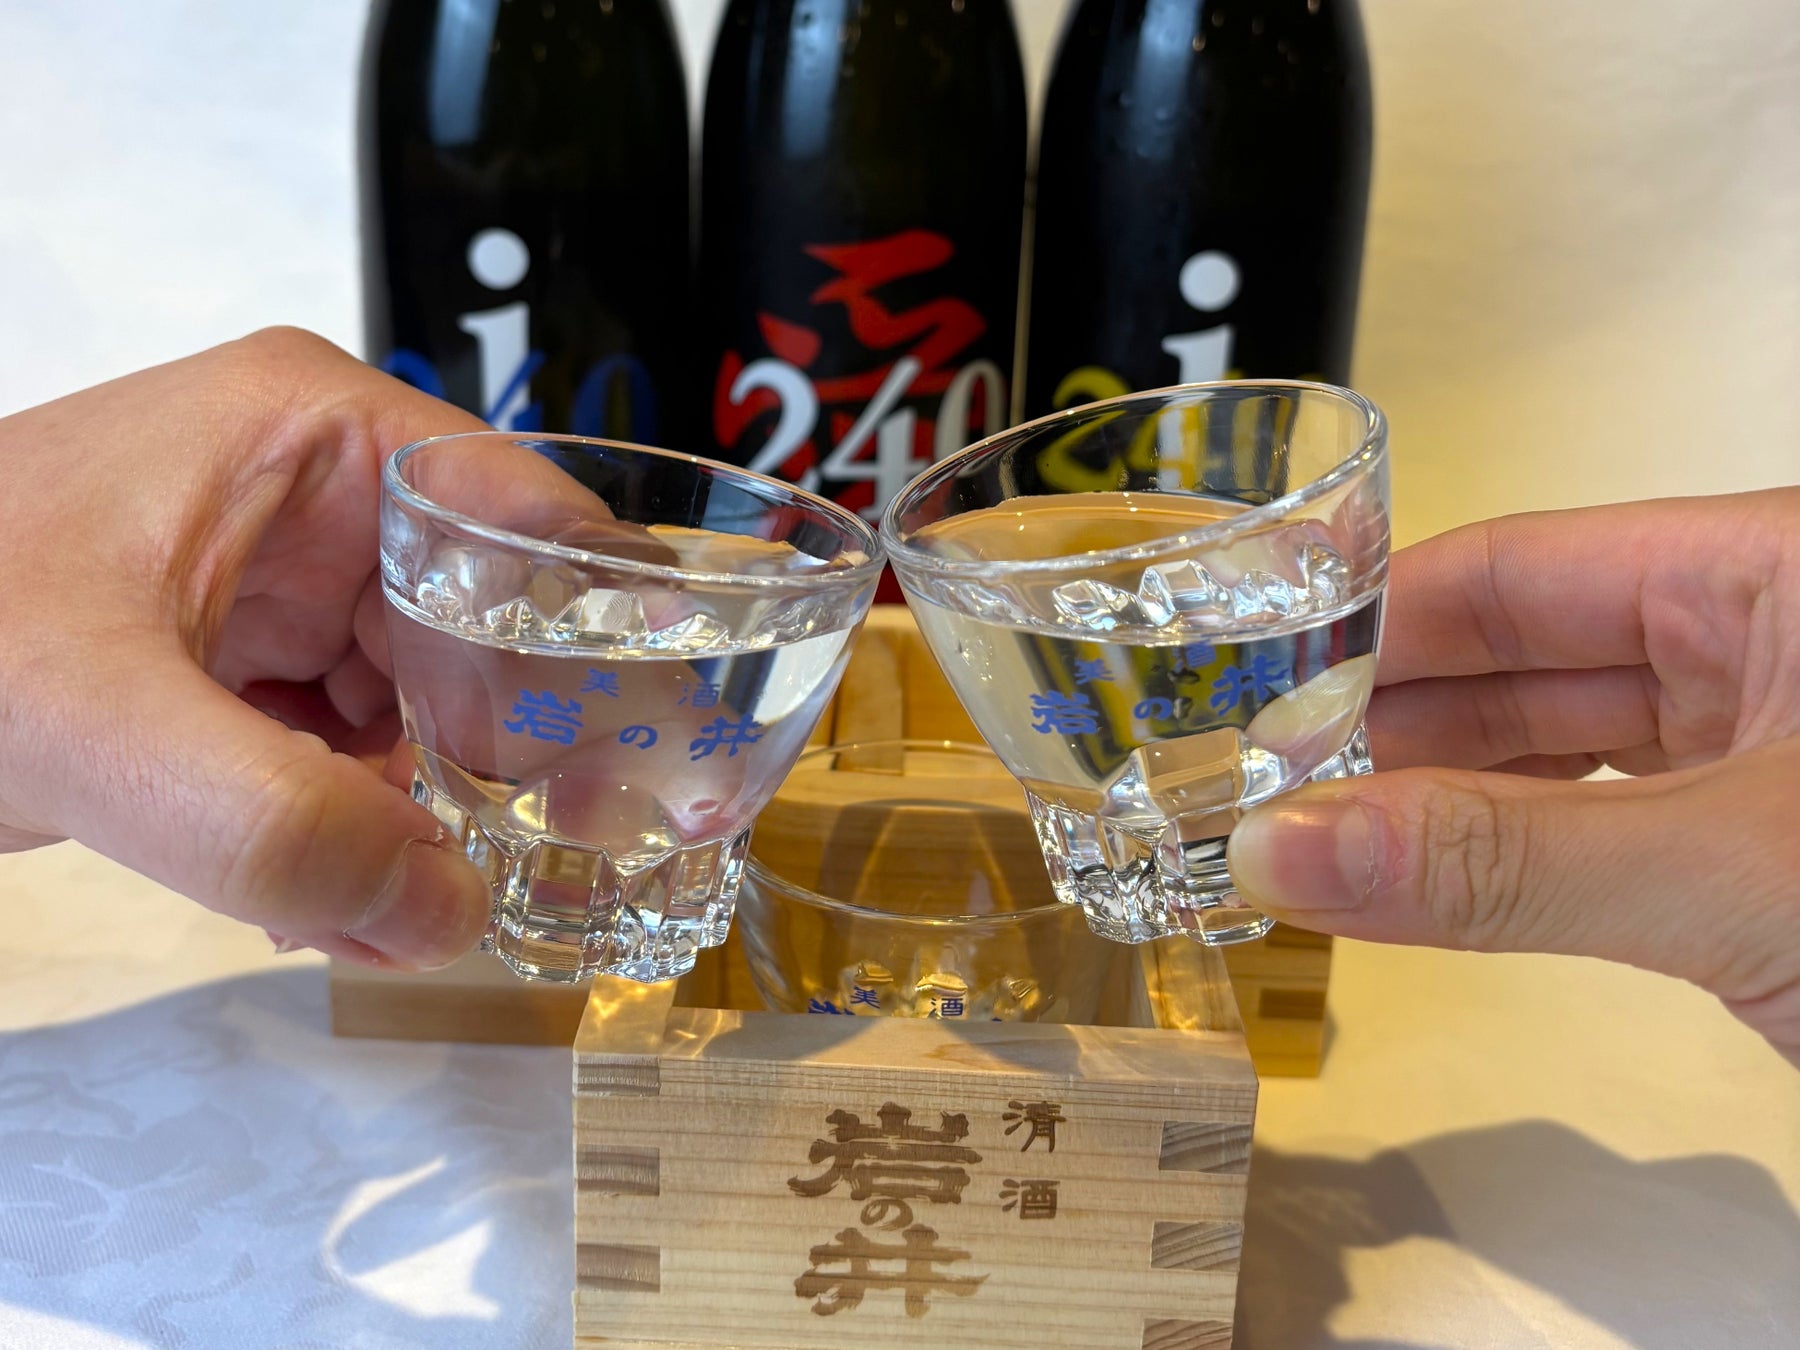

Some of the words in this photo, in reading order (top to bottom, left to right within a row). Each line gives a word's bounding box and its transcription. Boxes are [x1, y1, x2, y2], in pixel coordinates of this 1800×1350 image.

[729, 355, 1008, 521] 240
[504, 689, 764, 762] 岩の井
[580, 668, 721, 709] 美酒
[1029, 654, 1290, 735] 岩の井
[851, 986, 963, 1018] 美酒
[999, 1100, 1067, 1220] 清酒
[787, 1101, 991, 1319] 岩の井
